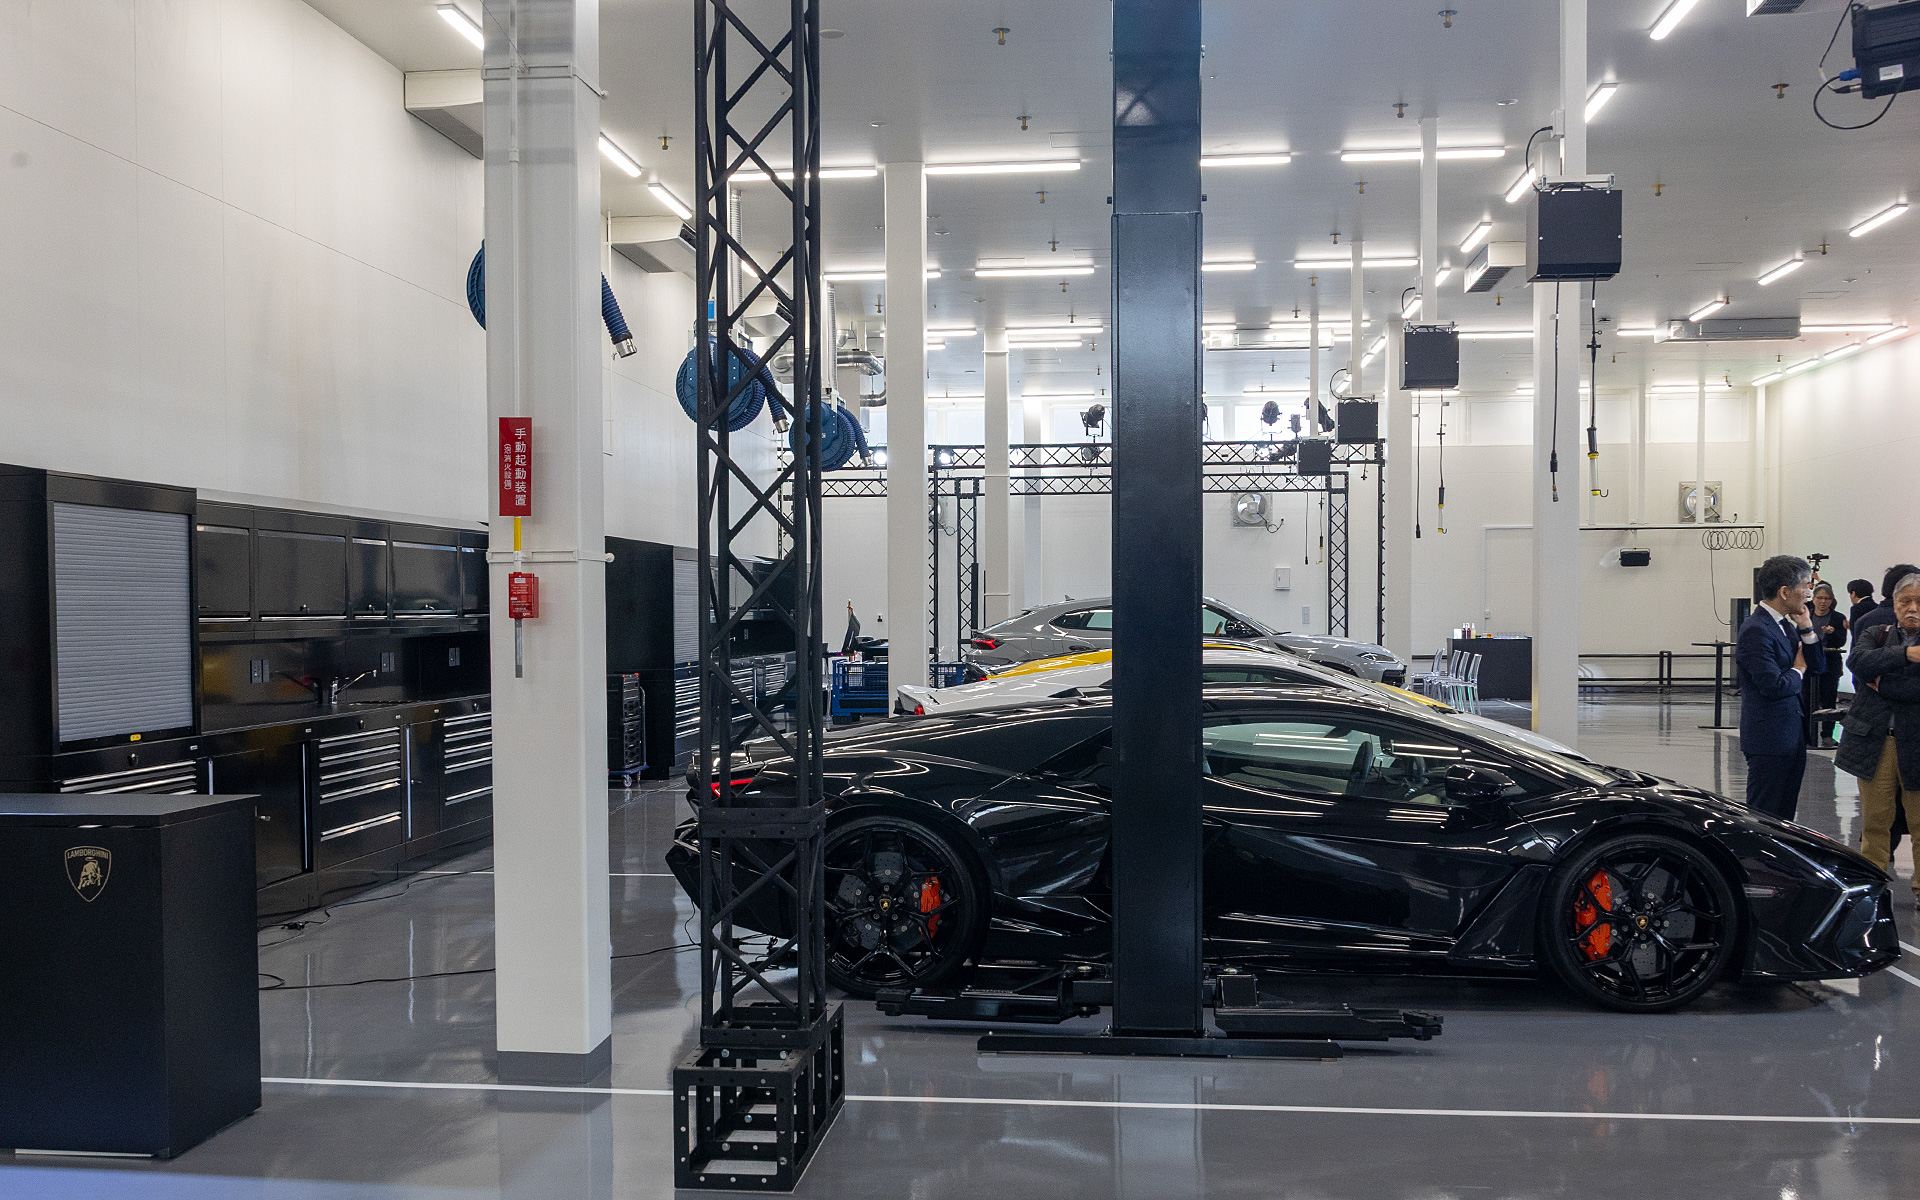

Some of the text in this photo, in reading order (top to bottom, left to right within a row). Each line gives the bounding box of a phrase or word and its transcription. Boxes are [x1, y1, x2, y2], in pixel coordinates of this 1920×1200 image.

[514, 427, 527, 506] 手動起動装置
[67, 848, 109, 860] LAMBORGHINI
